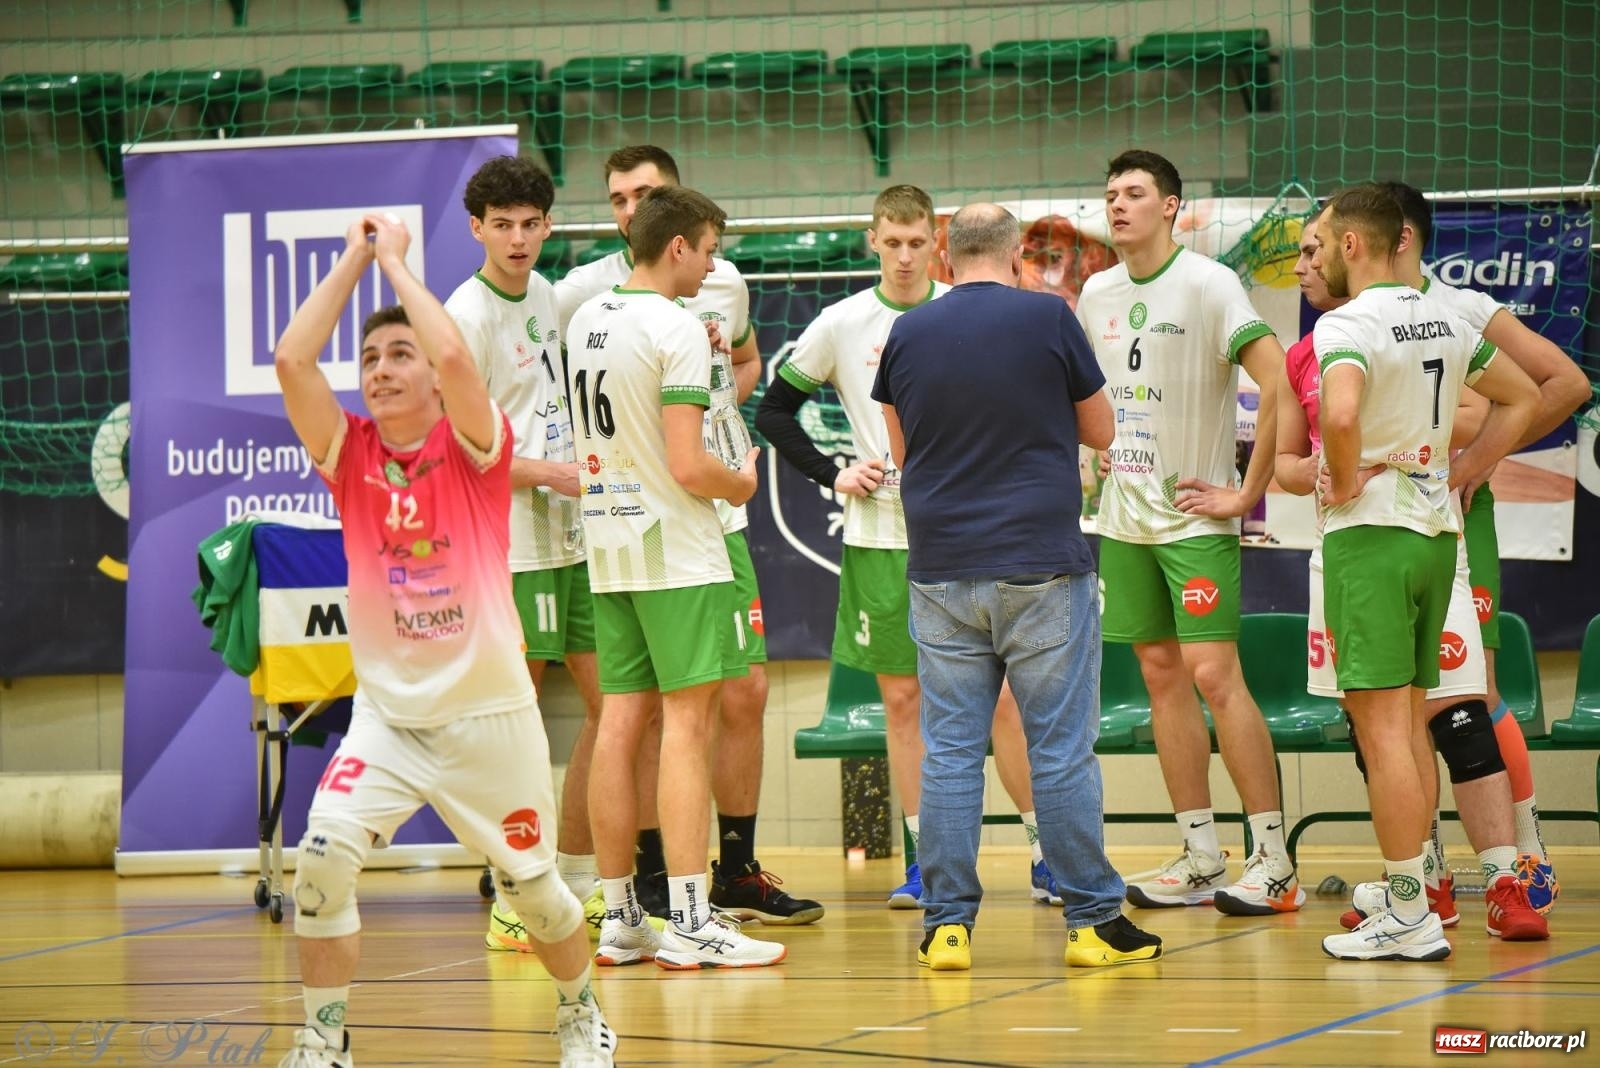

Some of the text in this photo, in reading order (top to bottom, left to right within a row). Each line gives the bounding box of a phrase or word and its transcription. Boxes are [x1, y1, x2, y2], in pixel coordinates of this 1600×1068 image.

[586, 329, 608, 349] ROŻ
[1128, 337, 1142, 372] 6
[574, 369, 616, 440] 16
[1110, 385, 1162, 402] VISON
[1423, 358, 1444, 429] 7
[167, 438, 313, 480] budujemy
[1387, 451, 1416, 462] radio
[384, 491, 424, 532] 42
[304, 603, 348, 637] M
[535, 592, 557, 632] 11
[855, 610, 870, 646] 3
